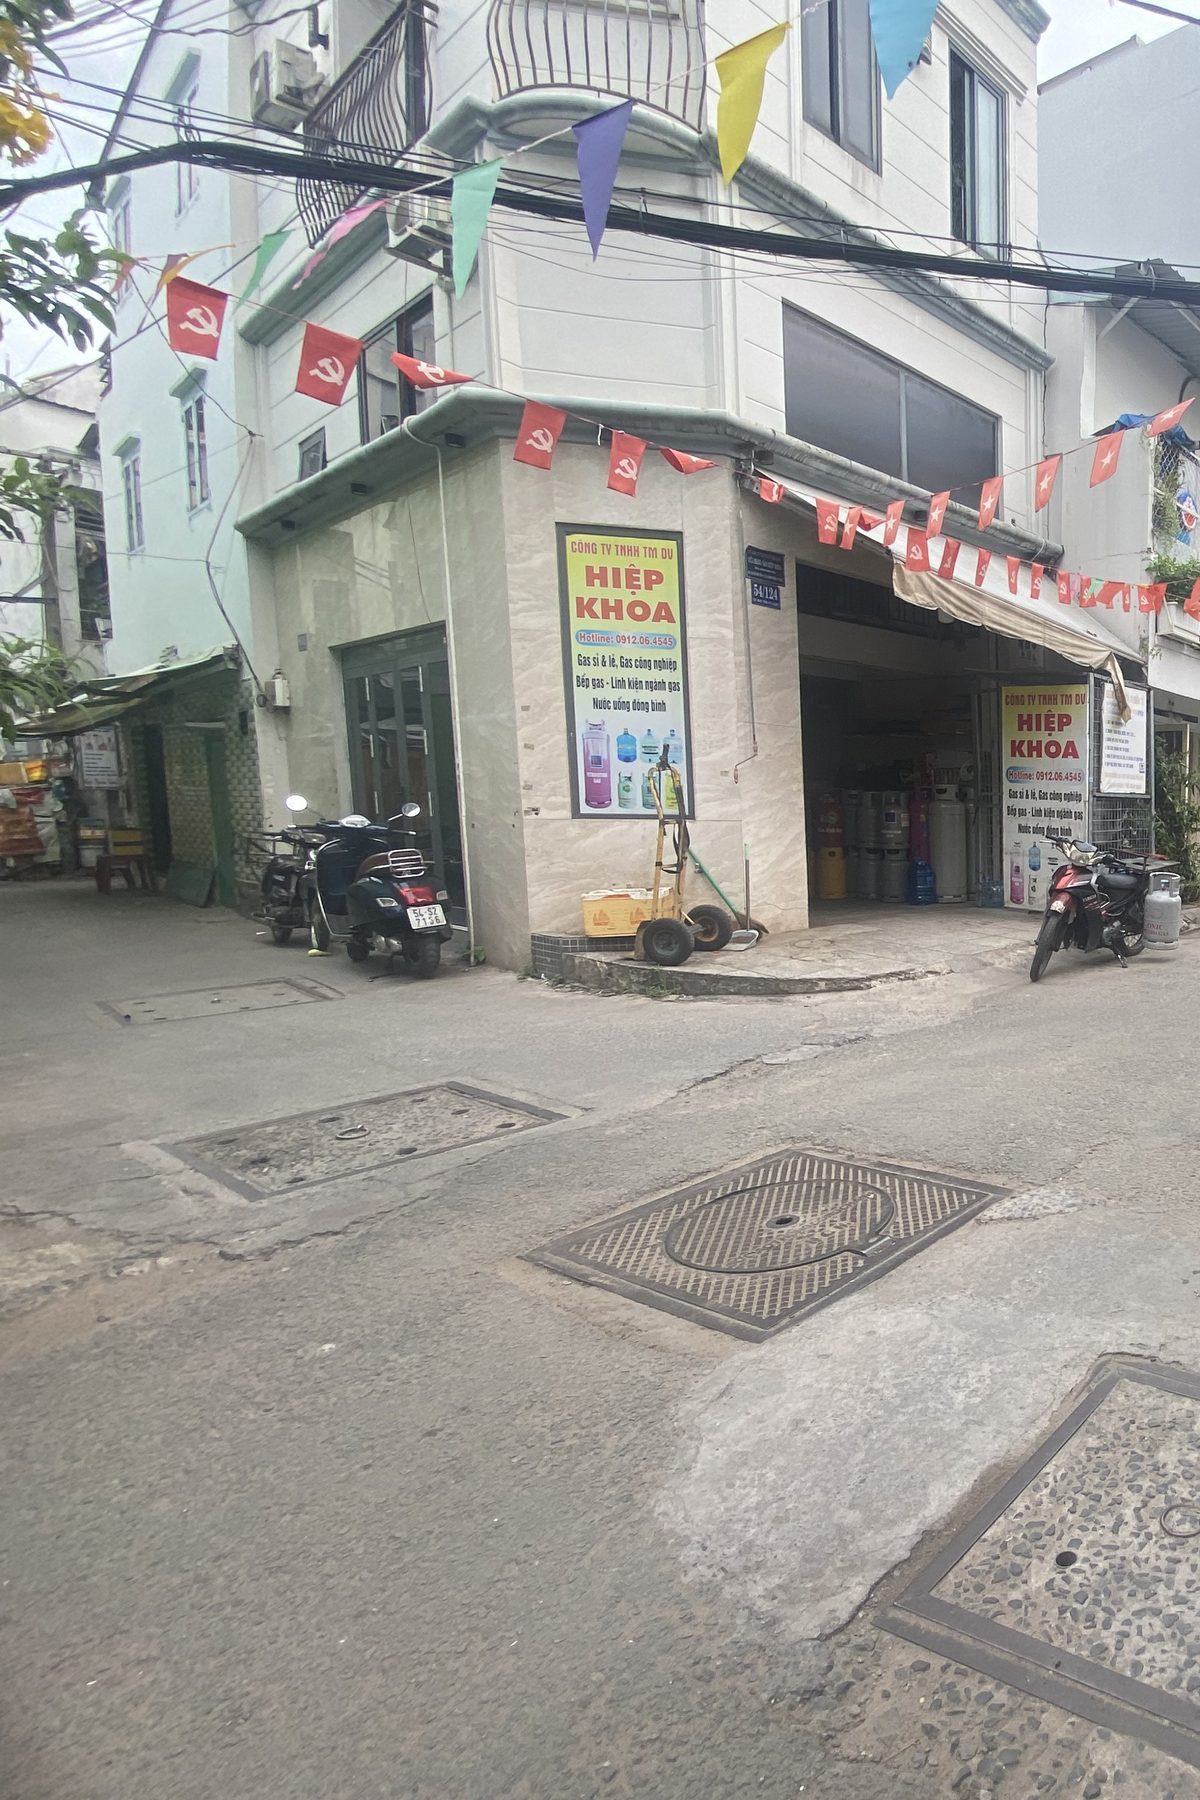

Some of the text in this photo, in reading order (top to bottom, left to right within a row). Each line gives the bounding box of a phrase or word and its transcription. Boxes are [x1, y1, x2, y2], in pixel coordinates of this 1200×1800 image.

[571, 540, 673, 560] CÔNG TY TNHH TM DV
[585, 563, 664, 595] HIỆP
[753, 583, 778, 601] 54/124
[576, 596, 676, 623] KHOA
[579, 632, 673, 646] Hotline: 0912.06.4545
[577, 653, 591, 667] Gas
[601, 655, 607, 668] &
[620, 655, 633, 669] Gas
[634, 656, 651, 670] công
[653, 657, 677, 673] nghiệp
[576, 673, 590, 689] Bếp
[591, 677, 605, 690] gas
[611, 676, 626, 690] Linh
[627, 676, 643, 693] kiện
[645, 678, 667, 692] ngành
[668, 681, 681, 693] gas
[592, 697, 612, 710] Nước
[613, 695, 631, 712] uống
[632, 698, 649, 713] đóng
[1005, 692, 1086, 706] CÔNG TY TNHH TM DV
[1017, 709, 1072, 737] HIỆP
[1010, 739, 1080, 759] KHOA
[1009, 770, 1082, 782] Hotline: 0912.06.4545
[1008, 788, 1018, 799] Gas
[1039, 789, 1048, 800] Gas
[1018, 807, 1027, 818] gas
[1031, 806, 1042, 817] Linh
